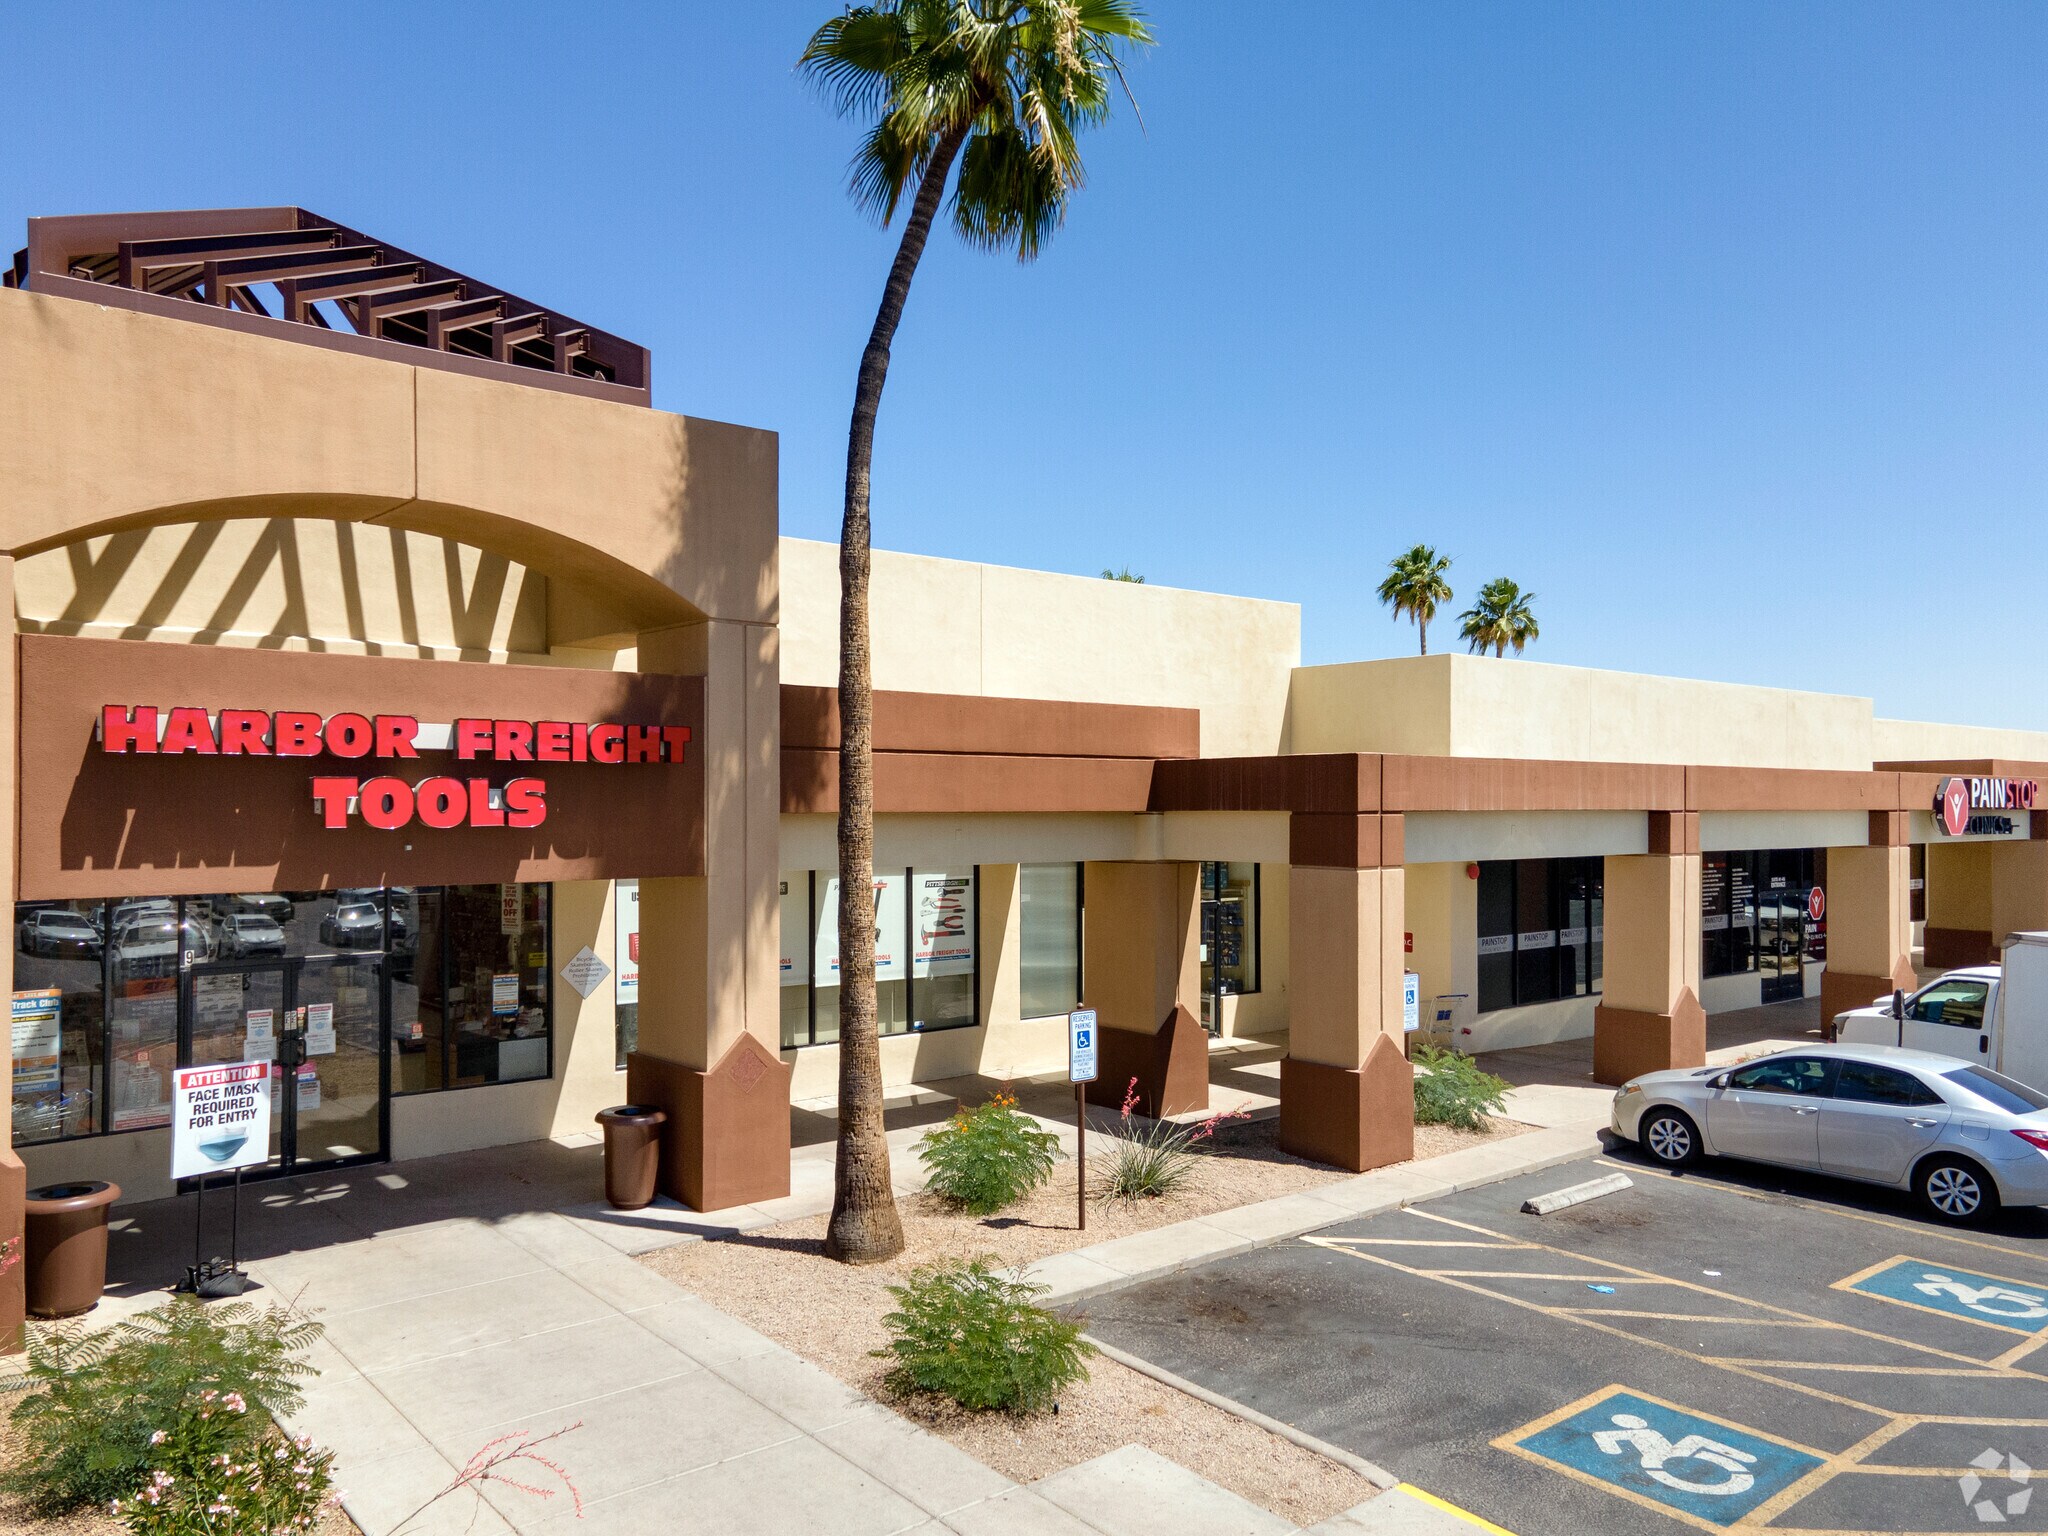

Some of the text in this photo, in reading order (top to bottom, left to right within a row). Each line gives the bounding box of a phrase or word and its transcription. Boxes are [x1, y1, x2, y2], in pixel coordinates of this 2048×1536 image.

[102, 704, 692, 764] HARBOR FREIGHT
[312, 775, 547, 830] TOOLS
[1971, 778, 2038, 809] PAINSTOP
[503, 908, 517, 916] OFF
[1481, 936, 1508, 947] PAINSTOP
[1524, 932, 1549, 942] PAINSTOP
[1561, 928, 1584, 938] PAINSTOP
[186, 951, 193, 964] 9
[187, 1066, 260, 1087] ATTENTION
[188, 1082, 260, 1103] FACE MASK
[193, 1096, 254, 1116] REQUIRED
[189, 1116, 214, 1130] FOR
[218, 1108, 258, 1124] ENTRY
